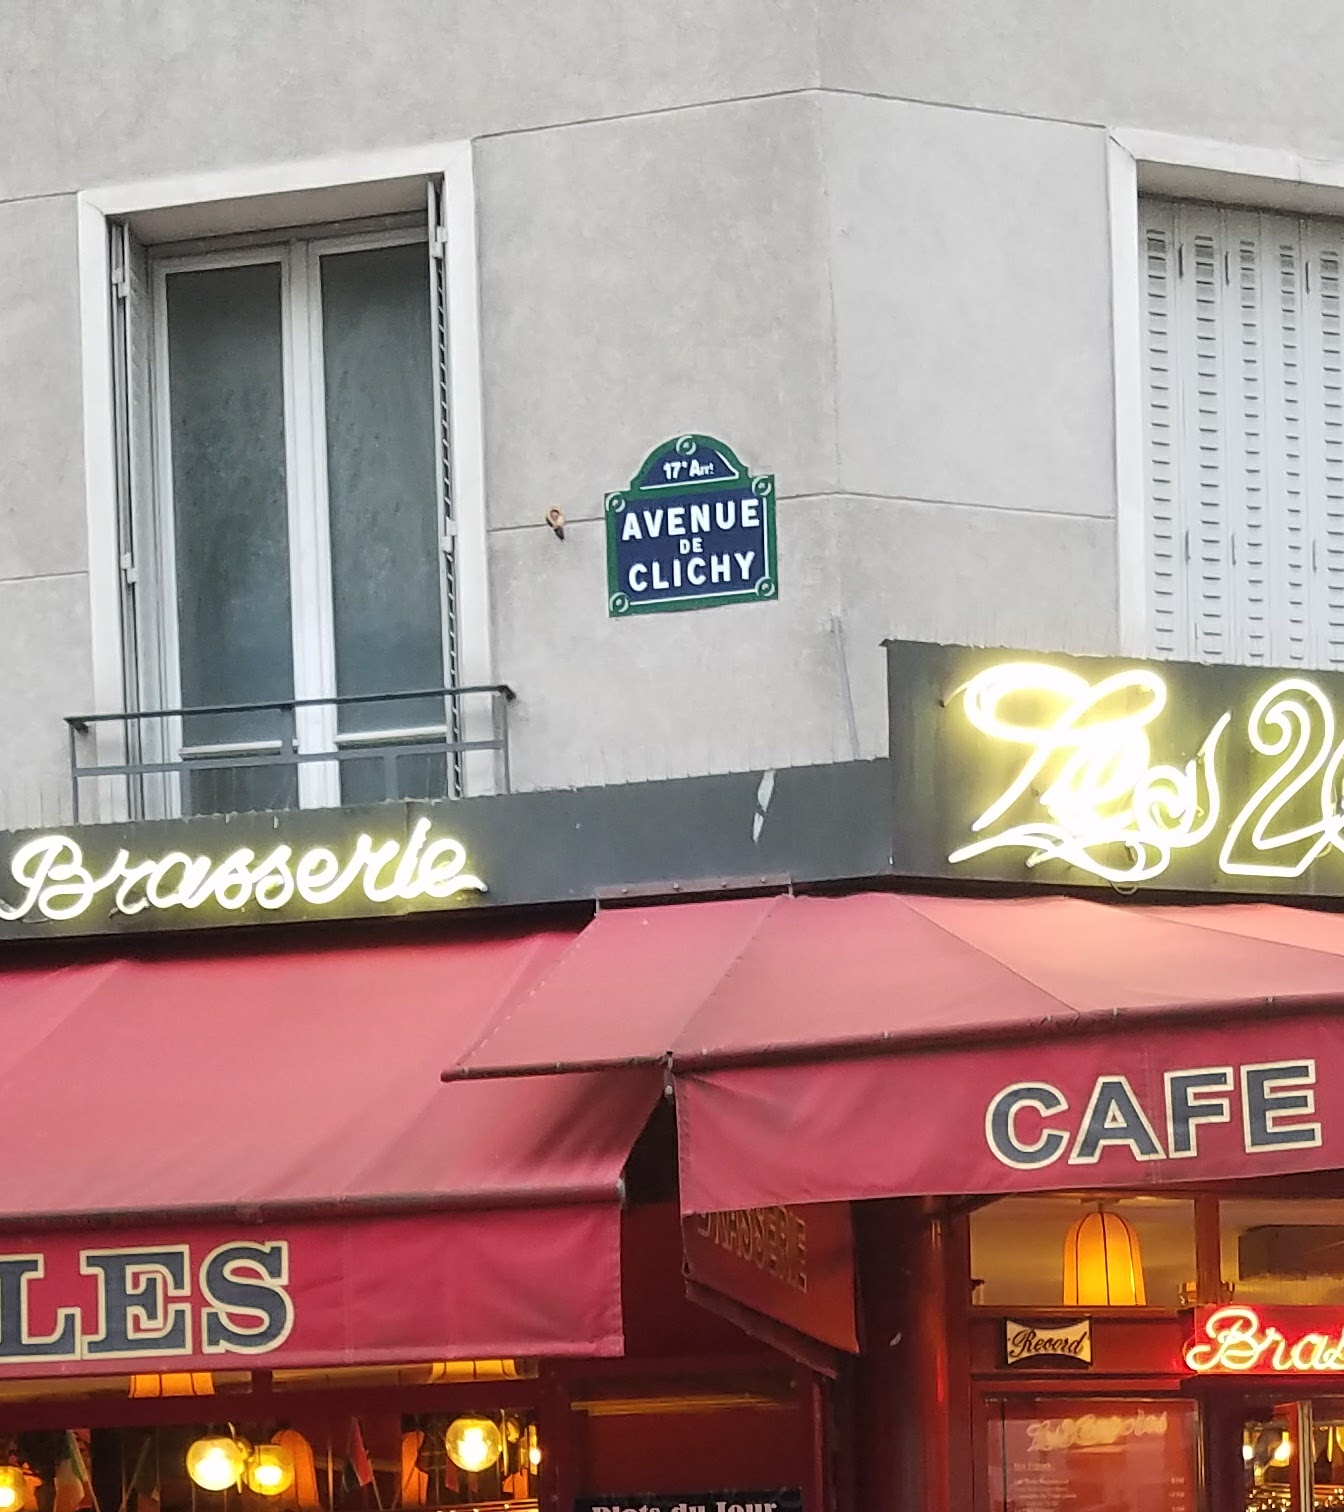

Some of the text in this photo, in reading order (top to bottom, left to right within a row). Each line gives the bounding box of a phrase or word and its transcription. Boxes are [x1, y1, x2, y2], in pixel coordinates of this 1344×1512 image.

[622, 498, 760, 541] AVENUE
[679, 537, 704, 555] DE
[628, 551, 756, 592] CLICHY
[947, 660, 1234, 884] Les
[984, 1058, 1324, 1172] CAFE
[1008, 1327, 1088, 1358] Record
